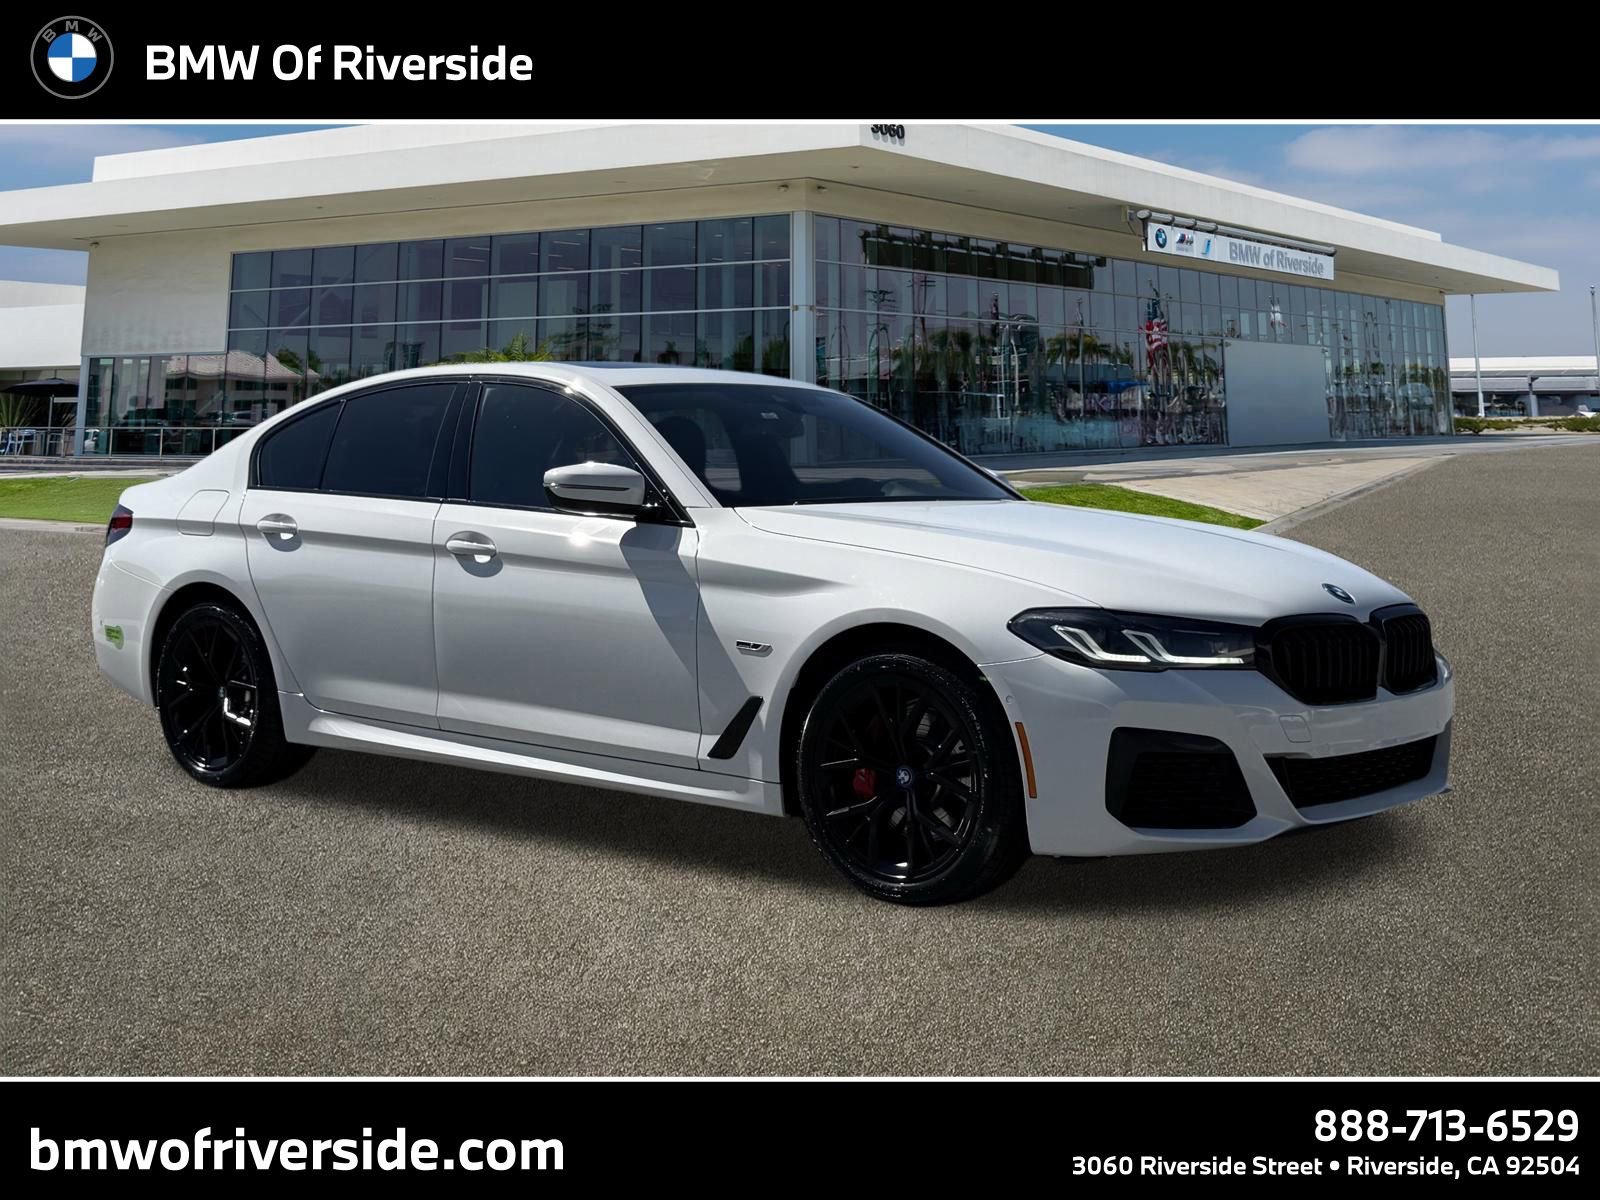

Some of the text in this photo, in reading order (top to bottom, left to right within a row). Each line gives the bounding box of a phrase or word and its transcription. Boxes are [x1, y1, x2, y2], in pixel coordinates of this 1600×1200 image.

[1229, 241, 1325, 276] BMW of Riverside
